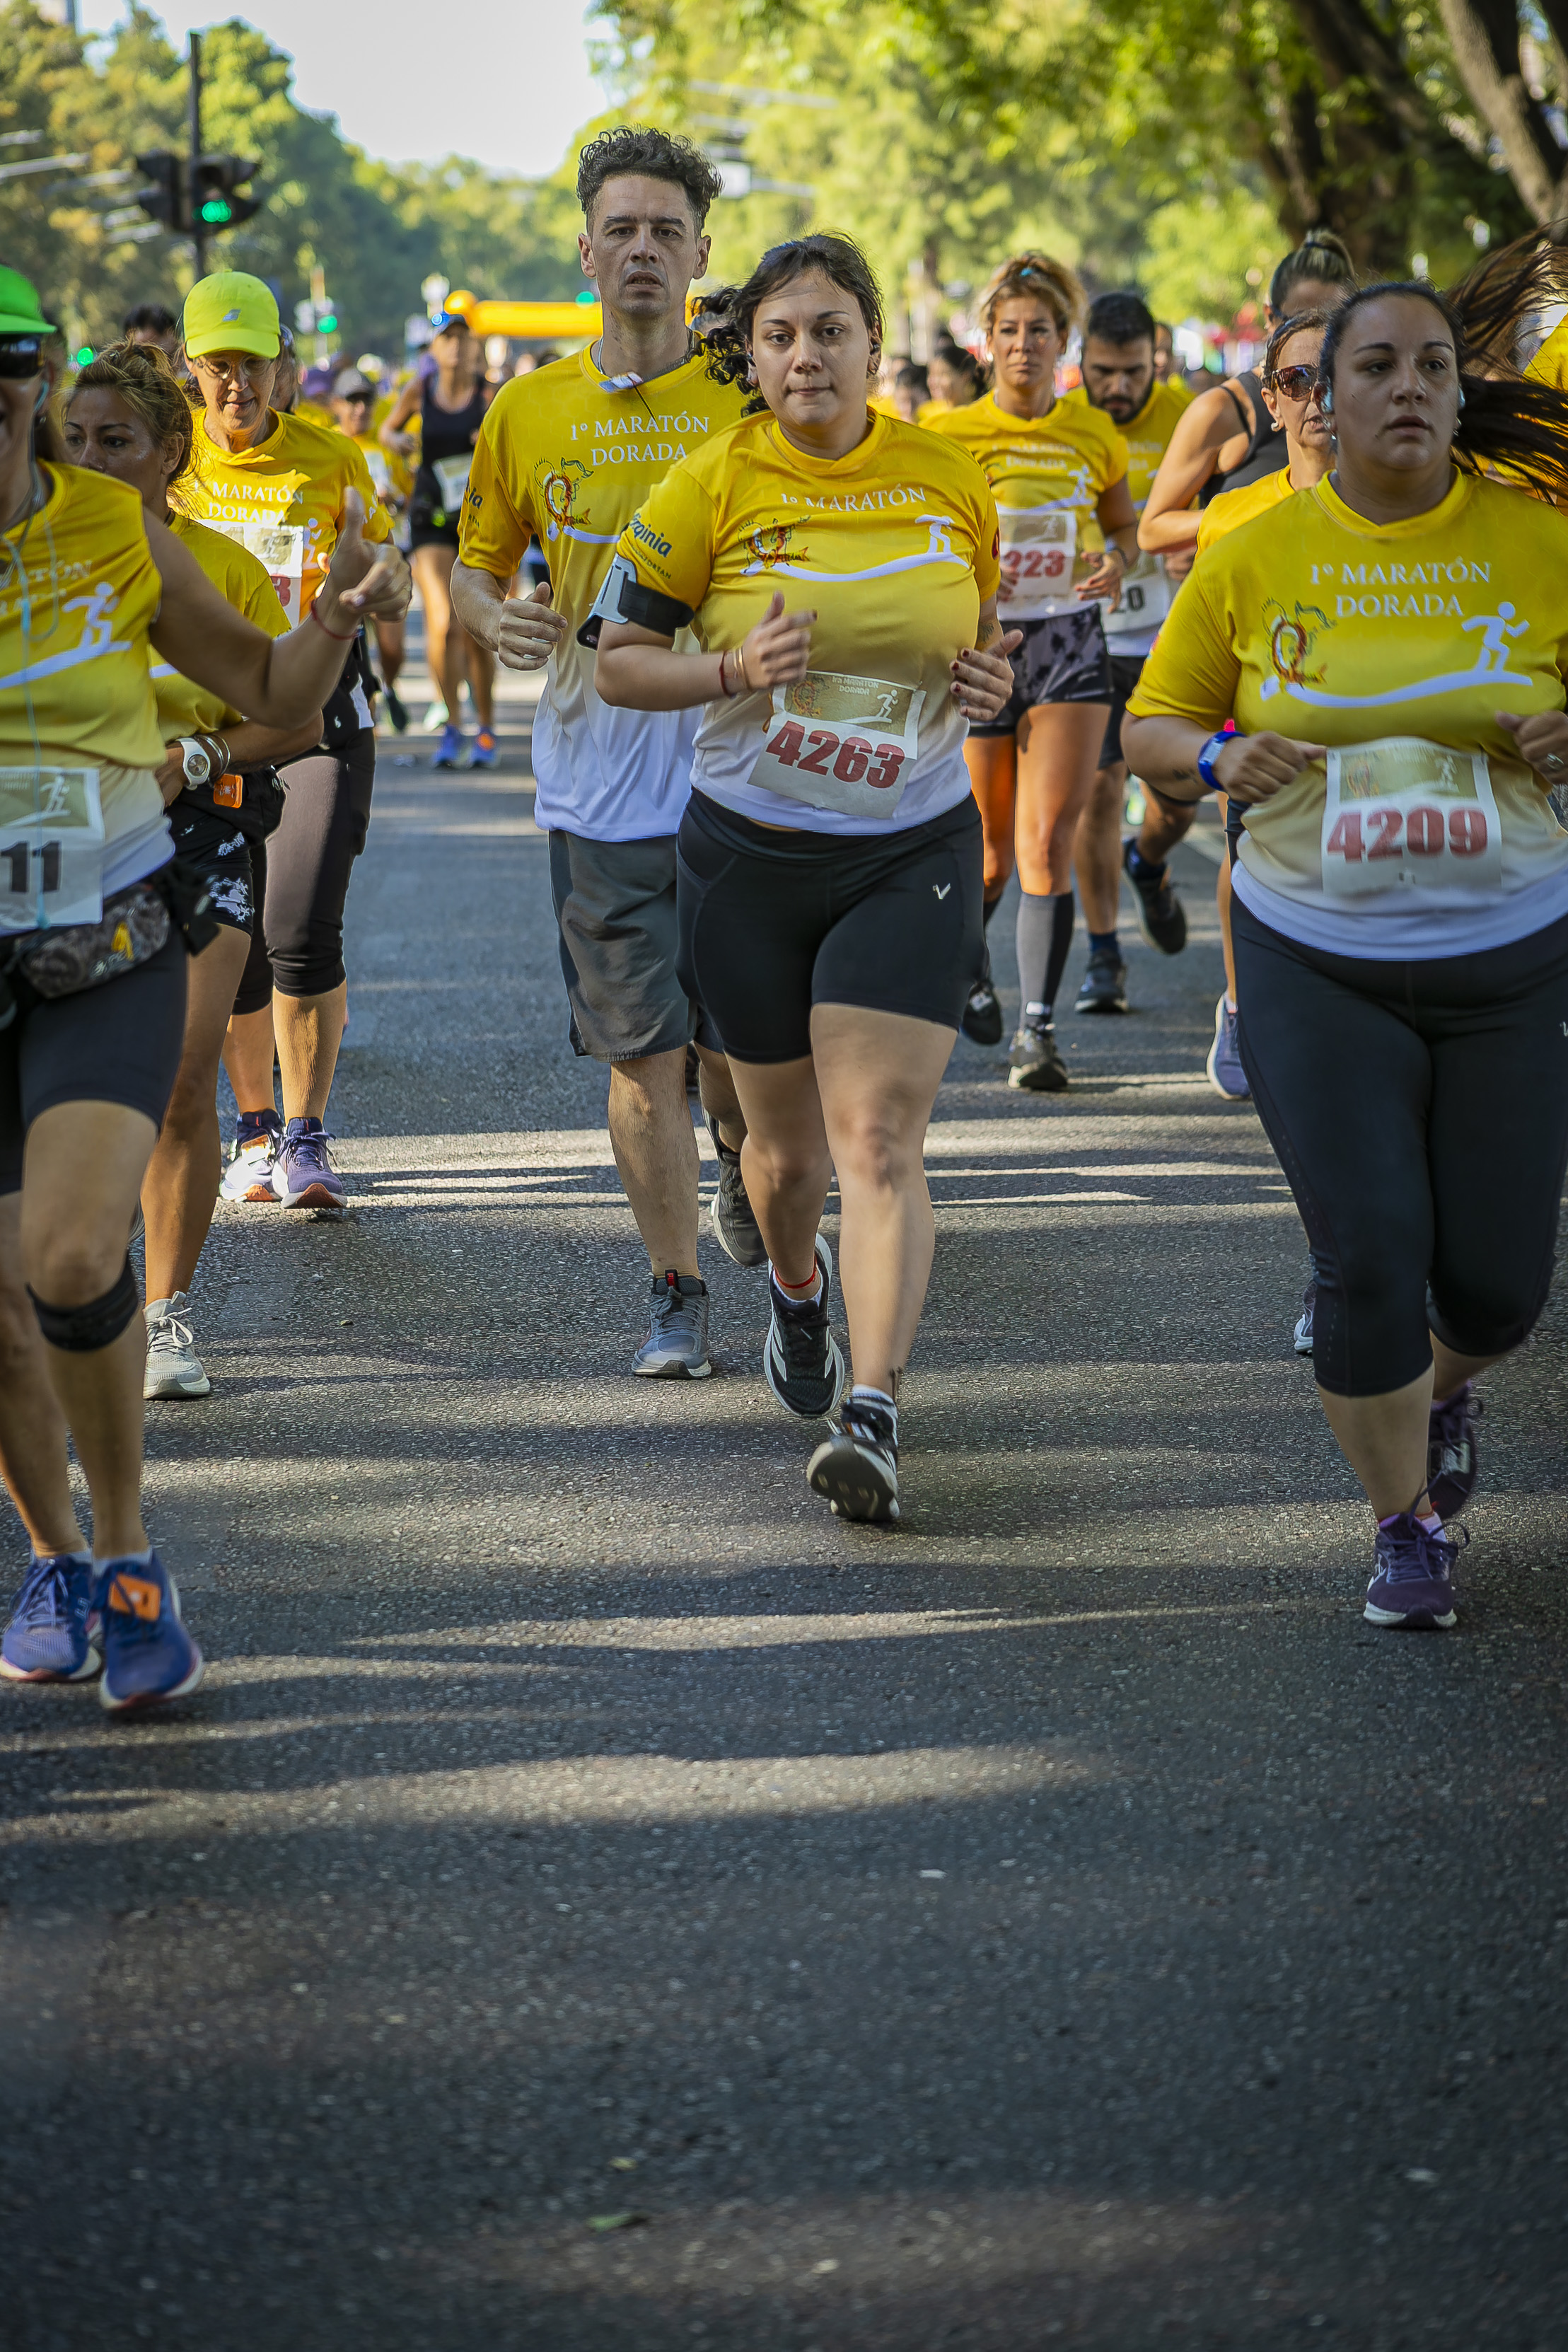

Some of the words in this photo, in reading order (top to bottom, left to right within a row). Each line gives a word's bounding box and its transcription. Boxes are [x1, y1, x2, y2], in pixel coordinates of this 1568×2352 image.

[594, 410, 709, 438] MARATÓN
[591, 443, 687, 466] DORADA
[212, 482, 303, 504] MARATÓN
[804, 484, 926, 511] MARATÓN
[1342, 557, 1491, 585] MARATÓN
[1336, 593, 1464, 618] DORADA
[839, 685, 870, 695] DORADA
[766, 720, 905, 789] 4263
[1328, 805, 1487, 863] 4209
